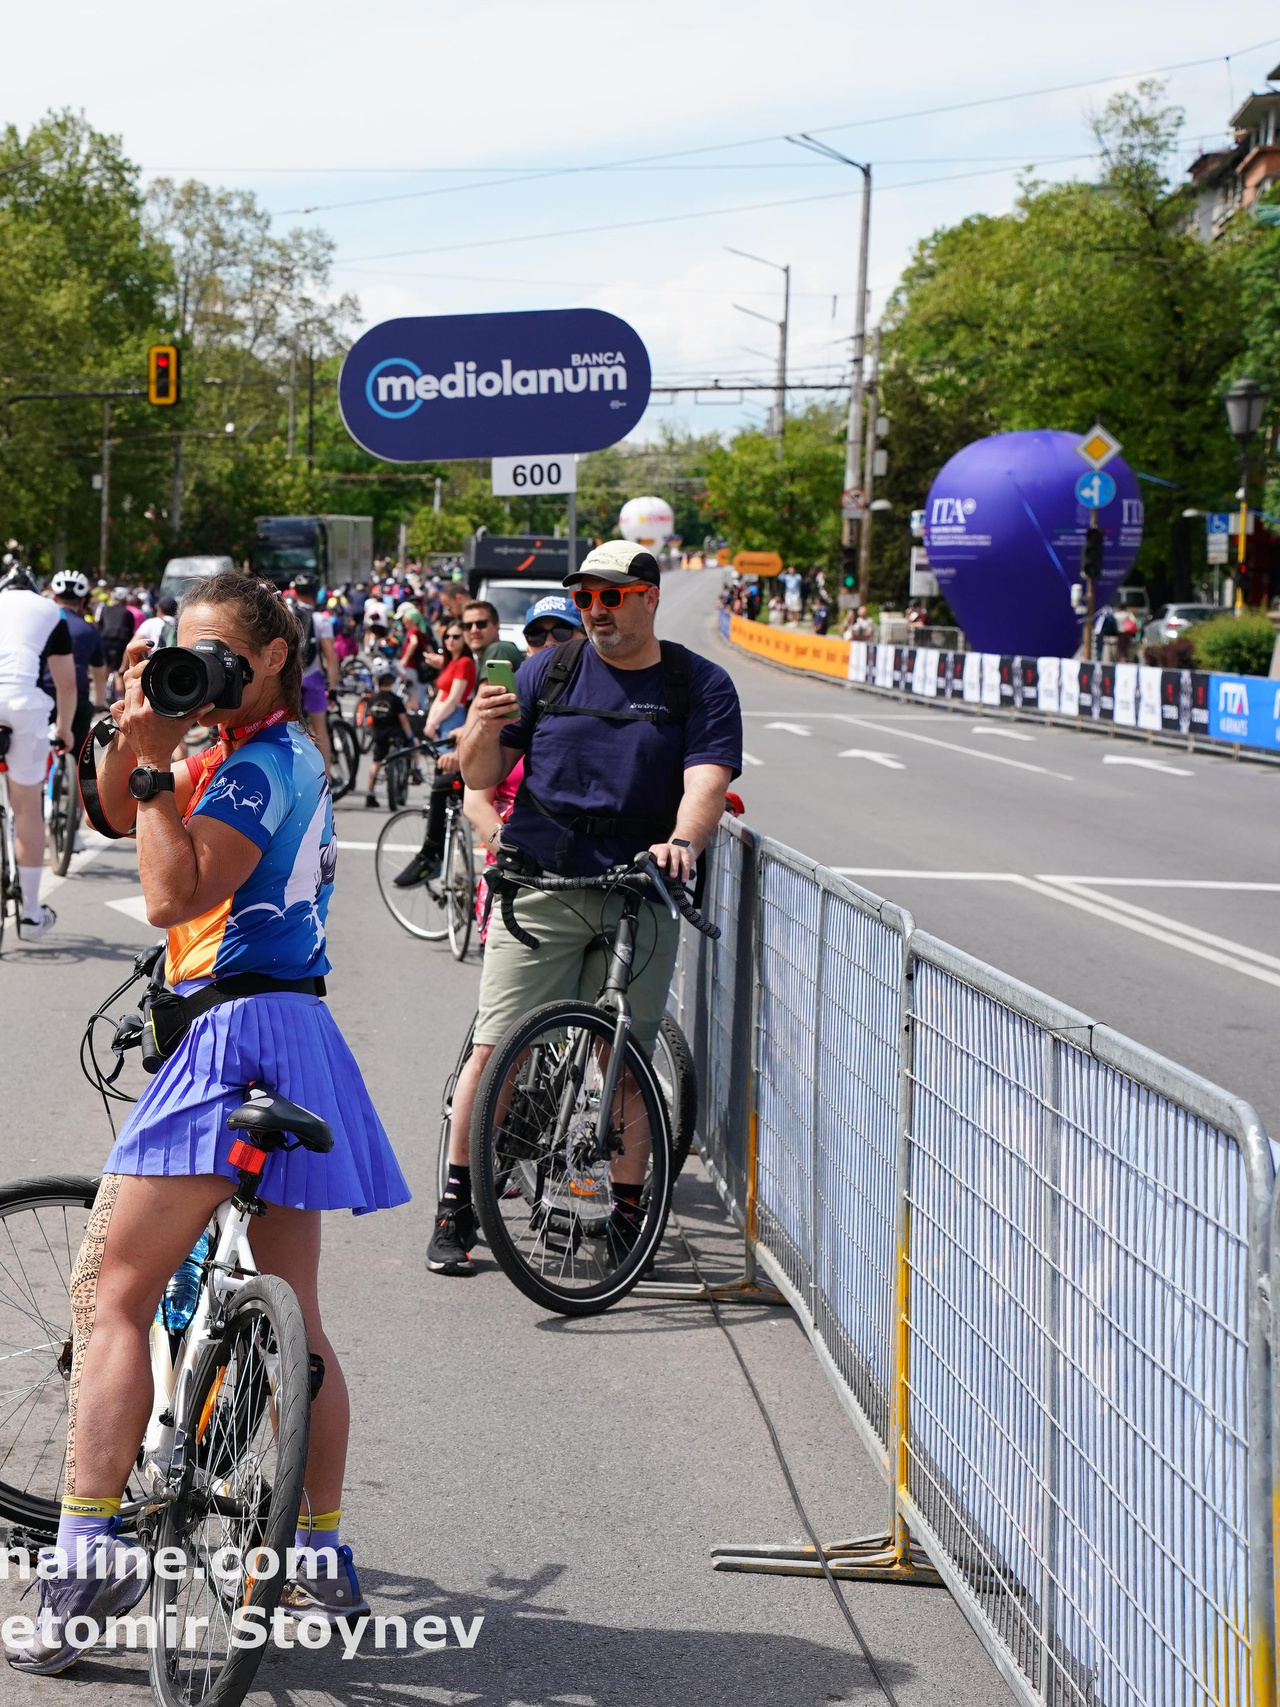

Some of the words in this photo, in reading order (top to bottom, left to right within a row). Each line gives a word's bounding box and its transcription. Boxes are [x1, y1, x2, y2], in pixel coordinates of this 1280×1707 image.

[571, 352, 626, 366] BANCA
[377, 359, 628, 402] mediolanum
[513, 463, 562, 486] 600
[931, 498, 966, 524] ITA
[533, 602, 567, 615] KONG
[1218, 682, 1250, 716] ITA
